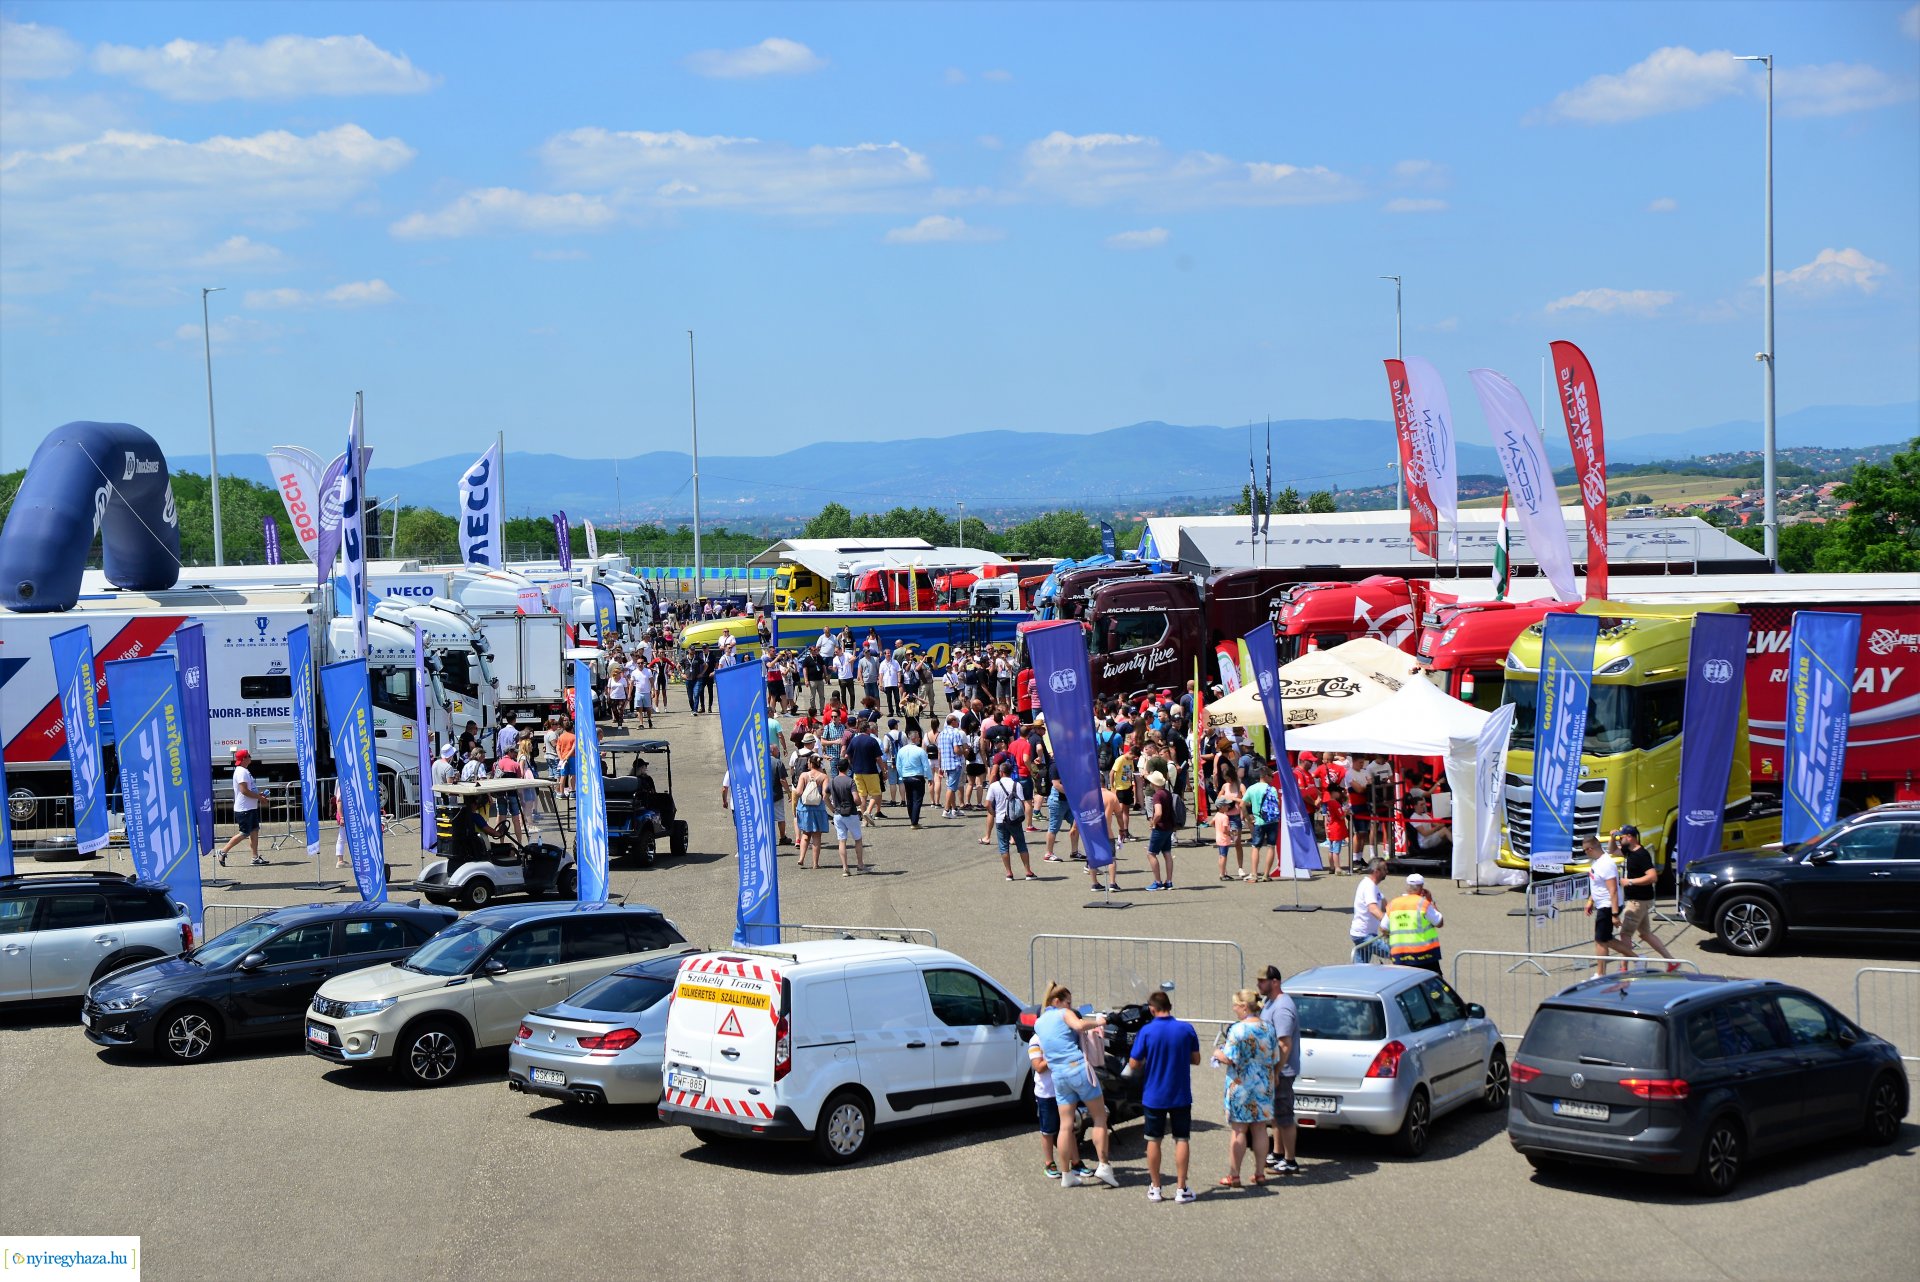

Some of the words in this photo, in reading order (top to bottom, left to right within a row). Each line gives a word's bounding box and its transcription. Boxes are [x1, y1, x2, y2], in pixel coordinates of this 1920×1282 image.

[1235, 537, 1412, 545] HEINRIC
[386, 586, 434, 597] IVECO
[1103, 652, 1147, 679] twenty
[1148, 647, 1174, 671] five
[1705, 664, 1731, 679] FIA
[1852, 667, 1905, 693] AY
[1543, 656, 1557, 730] GOODYEAR
[1794, 657, 1810, 733] GOODYEAR
[208, 707, 290, 718] KNORR-BREMSE
[43, 717, 65, 739] Trail
[1571, 714, 1581, 739] TRUCK
[729, 977, 762, 991] Trans
[1294, 1096, 1334, 1110] XD-737
